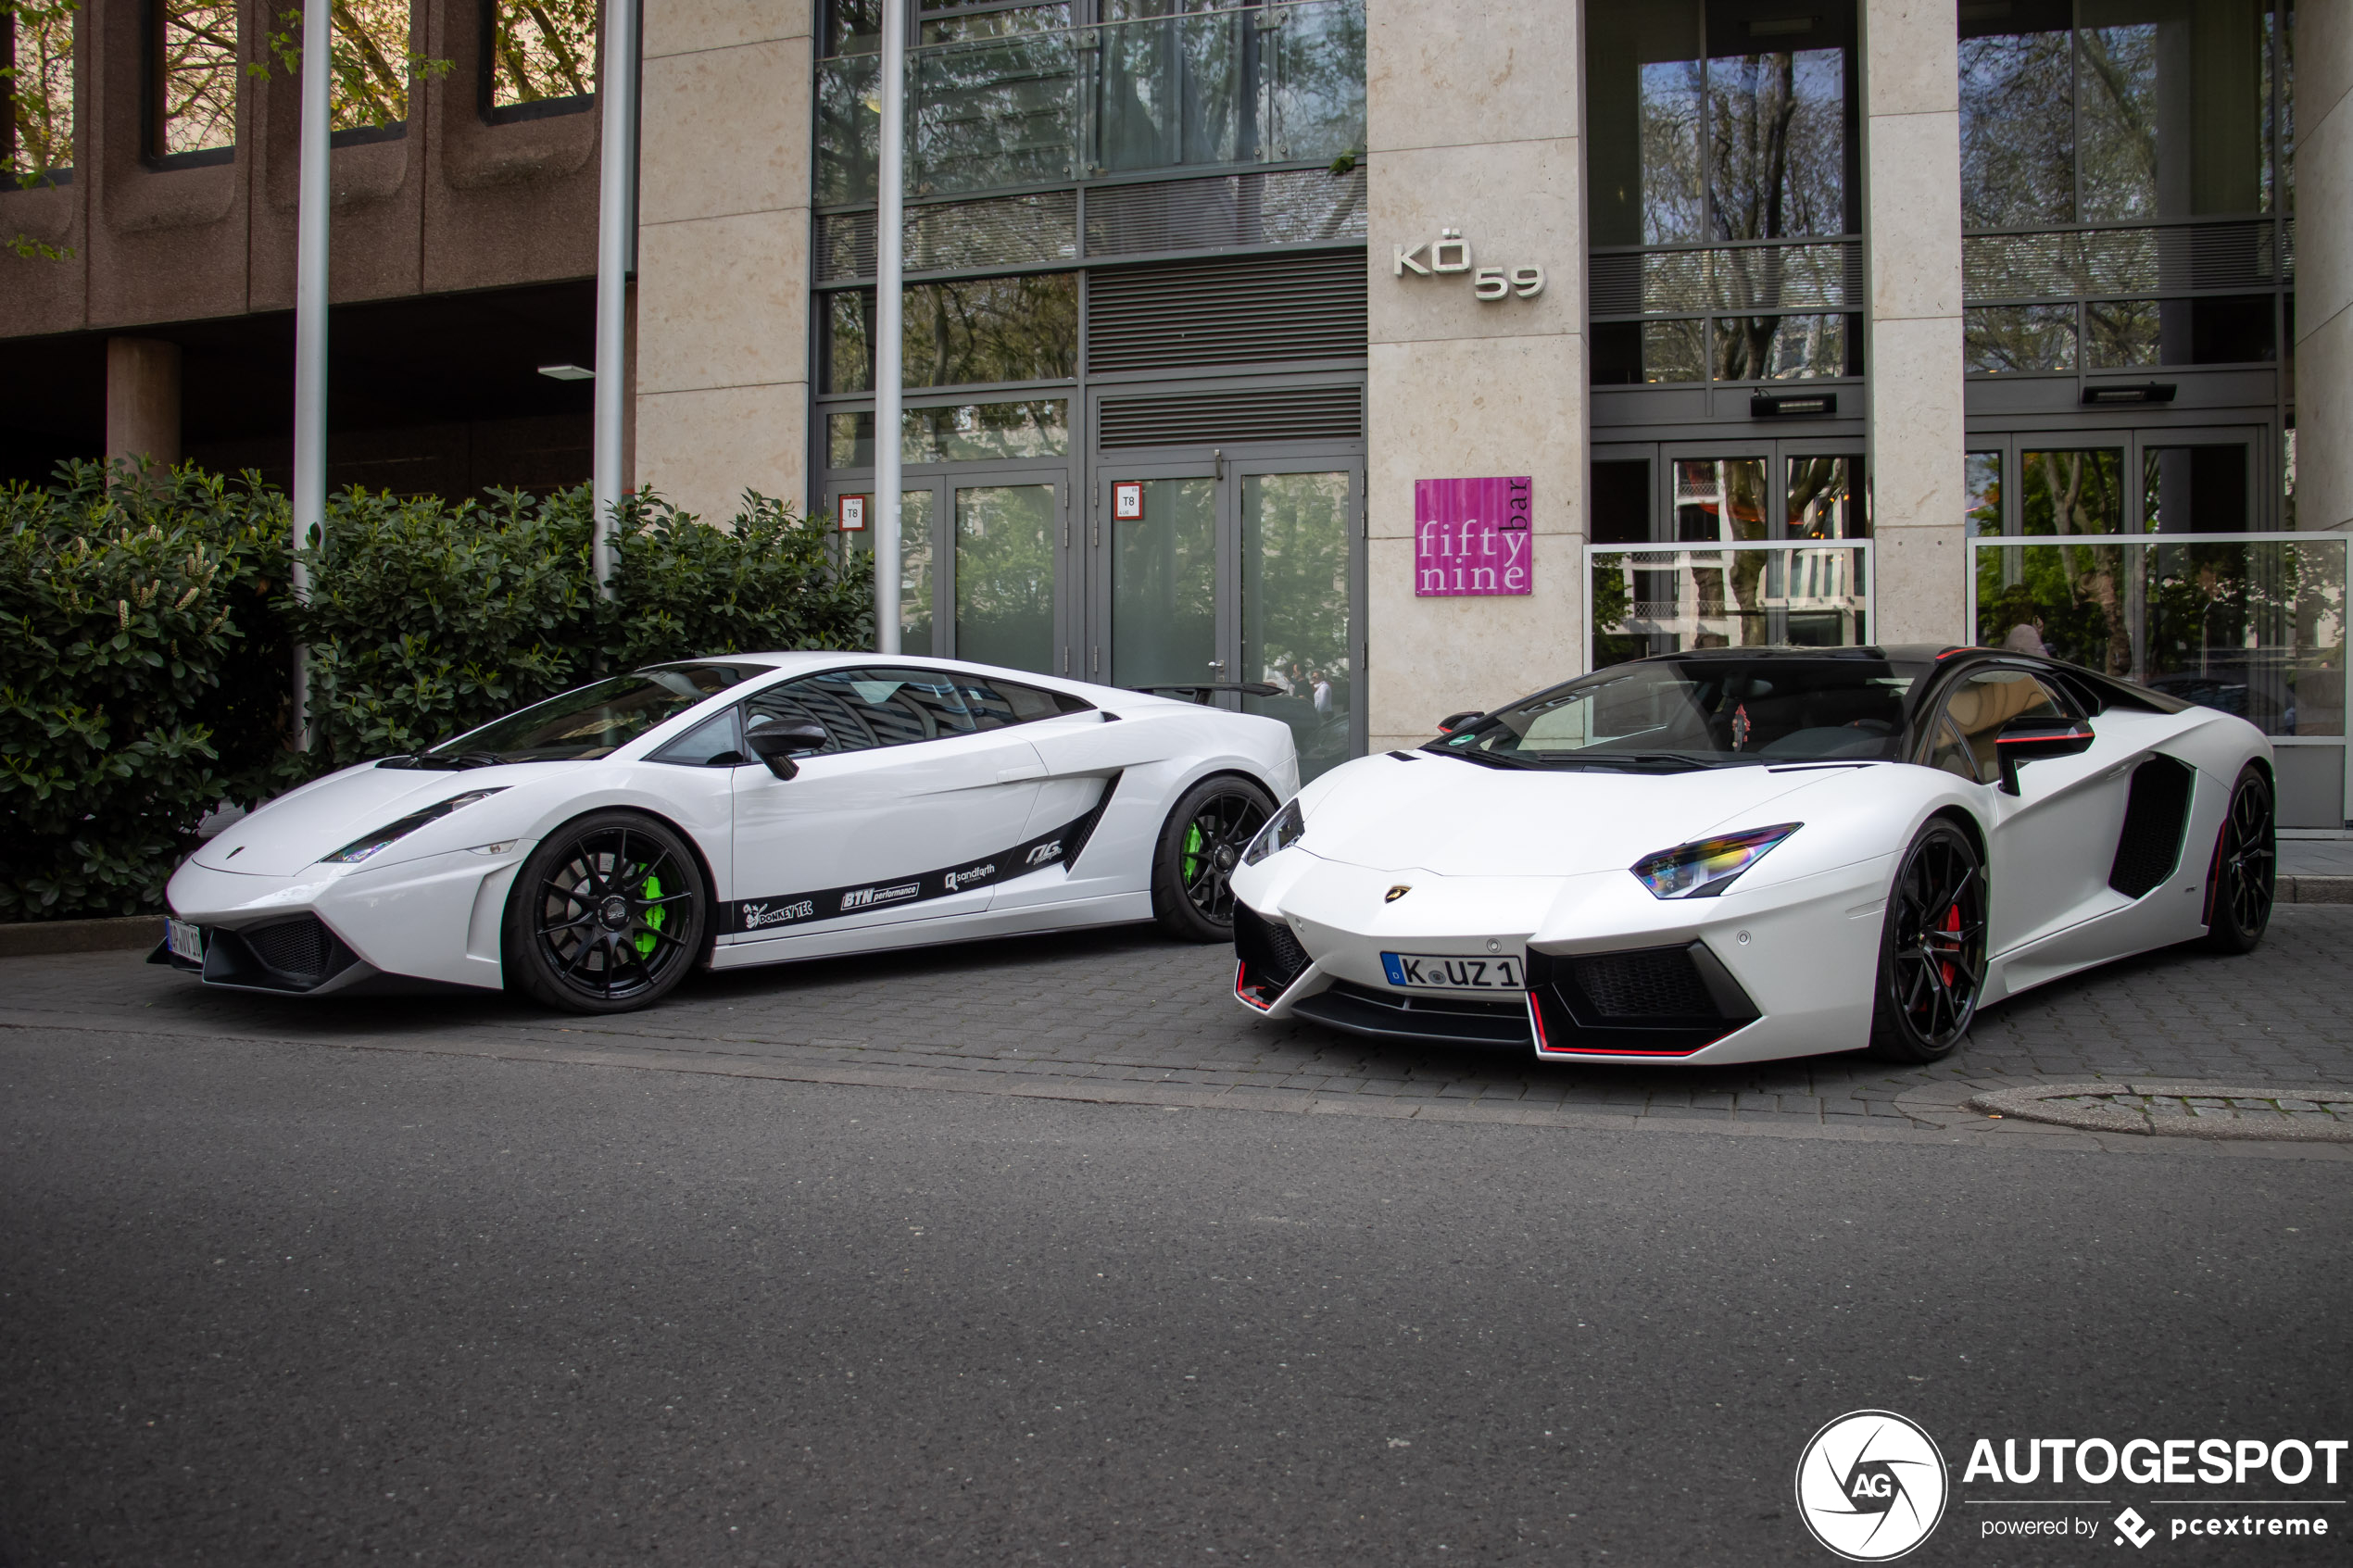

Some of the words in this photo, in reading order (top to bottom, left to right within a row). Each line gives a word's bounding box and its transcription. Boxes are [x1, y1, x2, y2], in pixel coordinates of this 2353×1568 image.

[1393, 228, 1472, 277] KÖ
[1475, 264, 1546, 301] 59
[847, 508, 859, 519] T8
[1123, 496, 1135, 507] T8
[1498, 480, 1528, 533] bar
[1418, 519, 1528, 568] fifty
[1420, 558, 1524, 591] nine
[956, 863, 996, 882] sandforth
[843, 887, 875, 908] BTN
[873, 885, 916, 903] performance
[759, 905, 795, 924] DONKEY
[795, 899, 813, 918] TEC
[1403, 959, 1428, 985] K
[1444, 960, 1492, 986] UZ
[1497, 961, 1519, 986] 1
